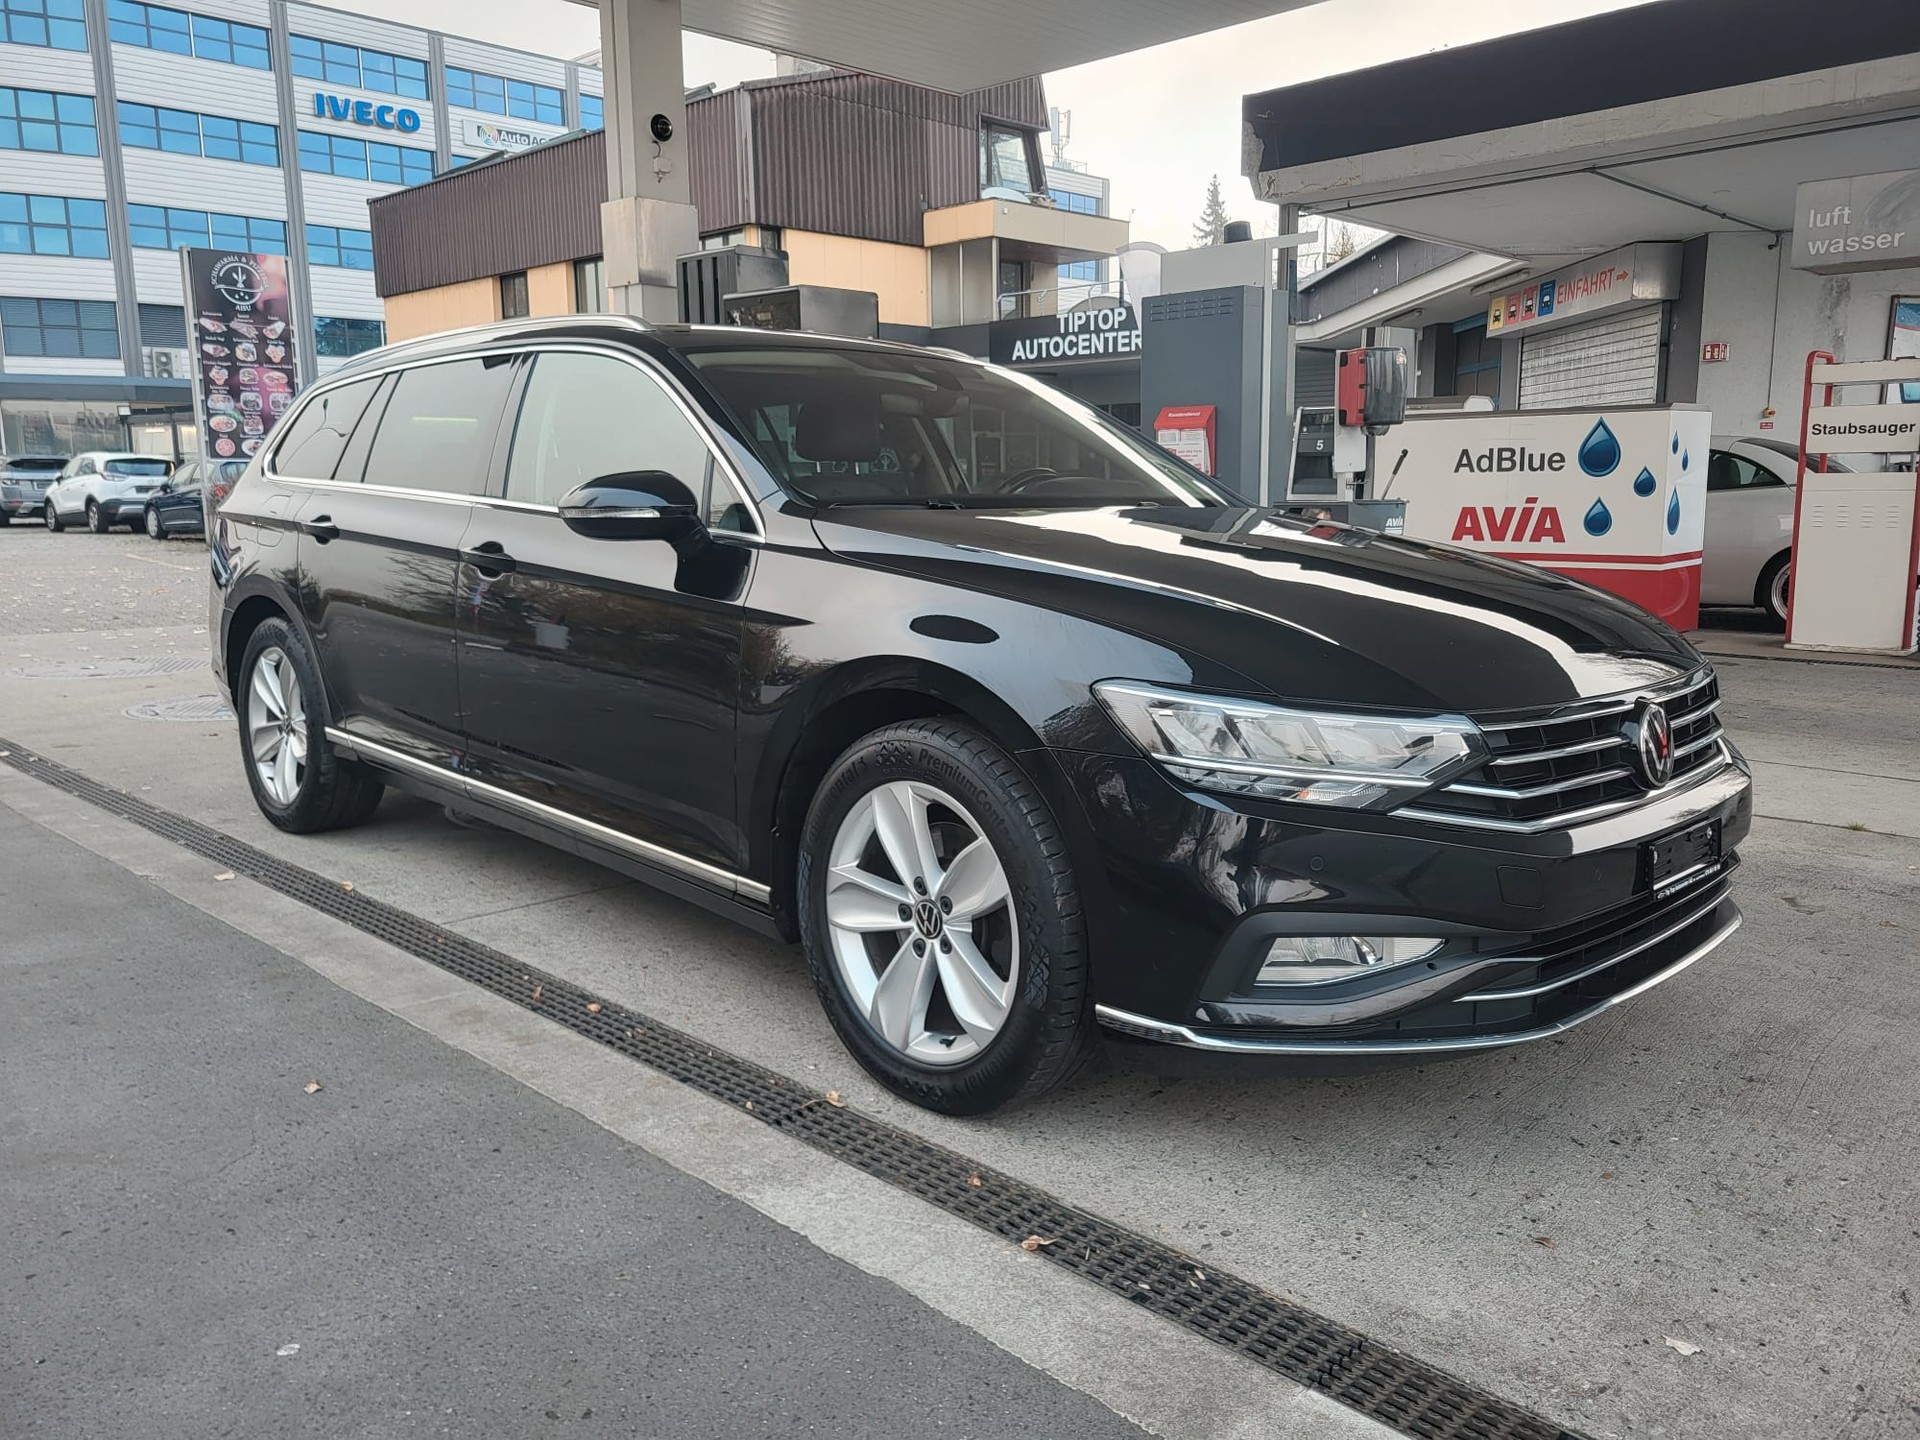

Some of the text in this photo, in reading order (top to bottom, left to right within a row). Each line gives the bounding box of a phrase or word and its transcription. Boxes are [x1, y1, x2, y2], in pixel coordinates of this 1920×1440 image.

[314, 93, 421, 133] IVECO
[500, 131, 529, 146] Auto
[1808, 206, 1851, 228] luft
[1808, 231, 1905, 255] wasser
[1556, 267, 1616, 305] EINFAHRT
[1057, 307, 1127, 333] TIPTOP
[1012, 330, 1142, 361] AUTOCENTER
[1811, 423, 1916, 436] Staubsauger
[1316, 440, 1324, 451] 5
[1453, 447, 1566, 473] AdBlue
